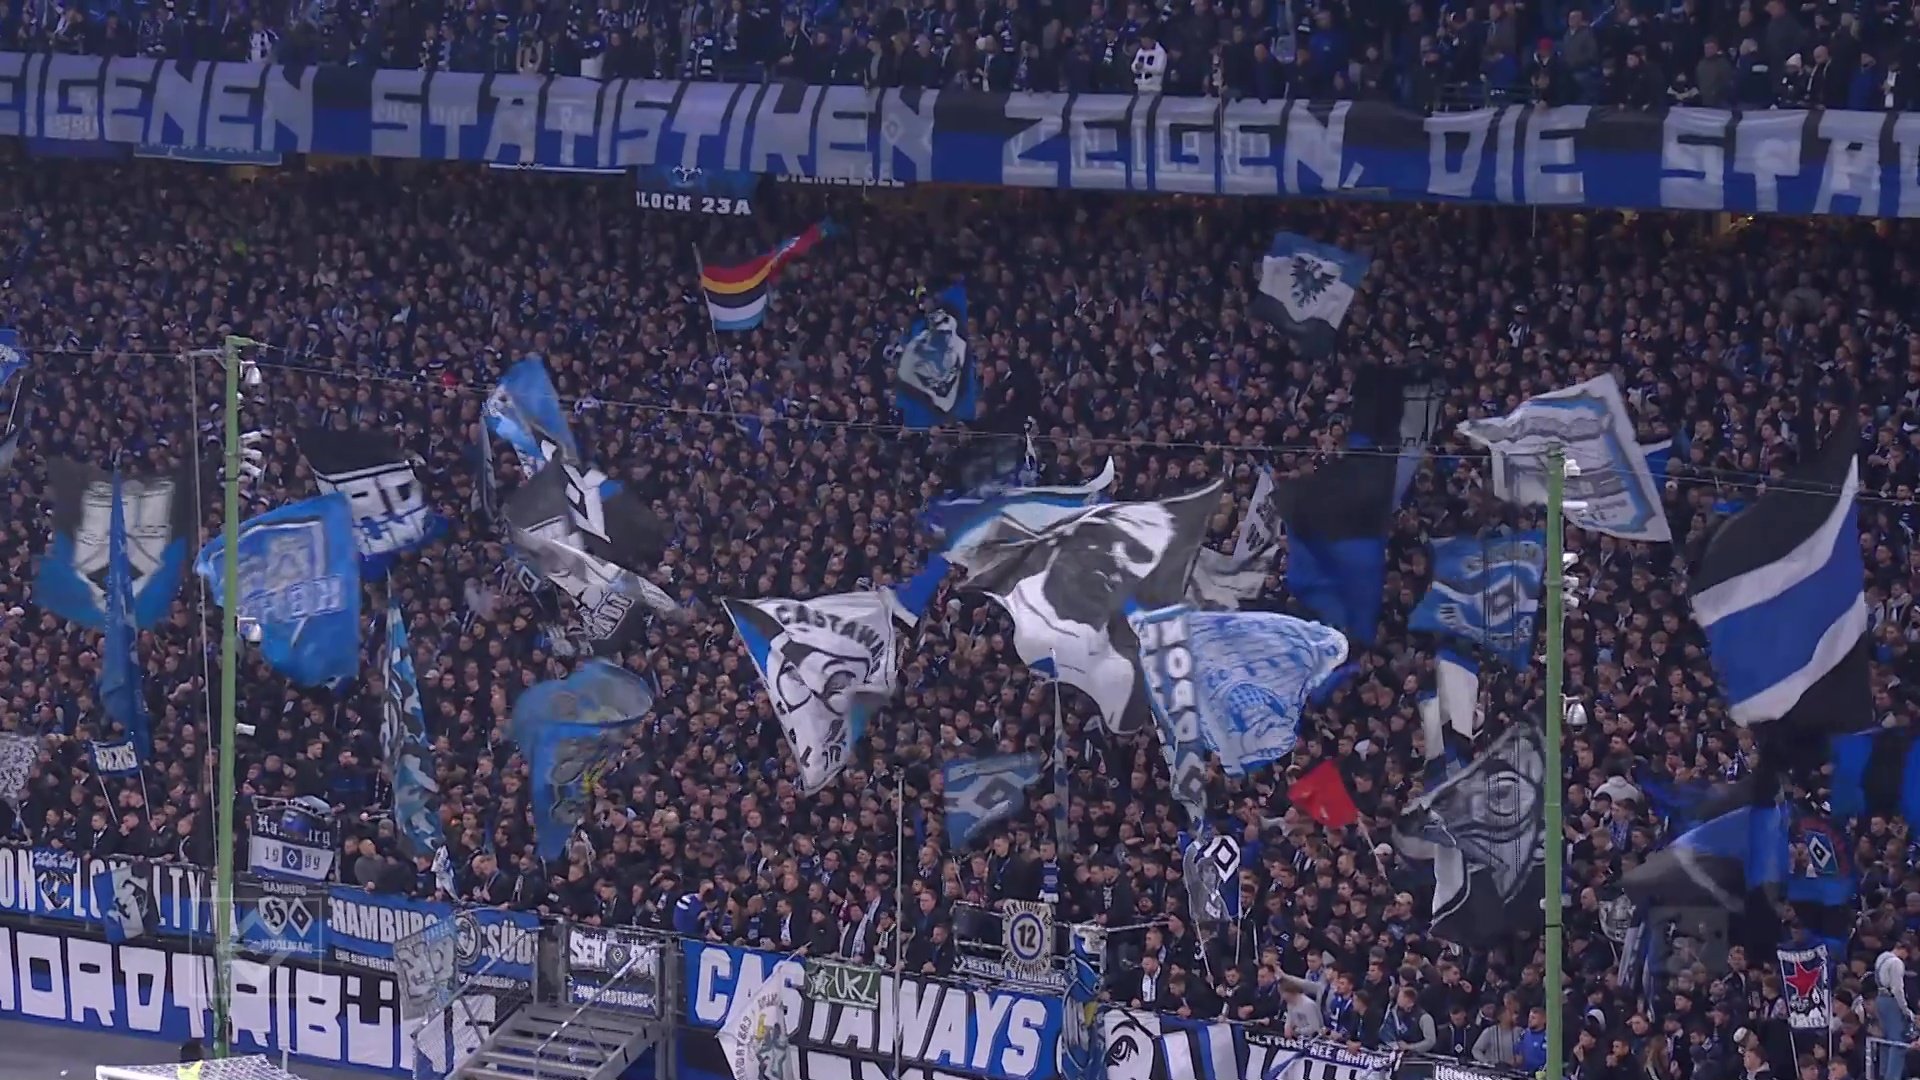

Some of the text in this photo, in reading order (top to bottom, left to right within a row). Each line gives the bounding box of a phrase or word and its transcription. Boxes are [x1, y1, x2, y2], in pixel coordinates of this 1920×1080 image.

[371, 70, 938, 184] STATISTIKEN
[1001, 91, 1364, 195] ZEIGEN,
[1424, 105, 1592, 204] DIE
[635, 190, 752, 216] LOCK 23A
[1018, 923, 1036, 949] 12
